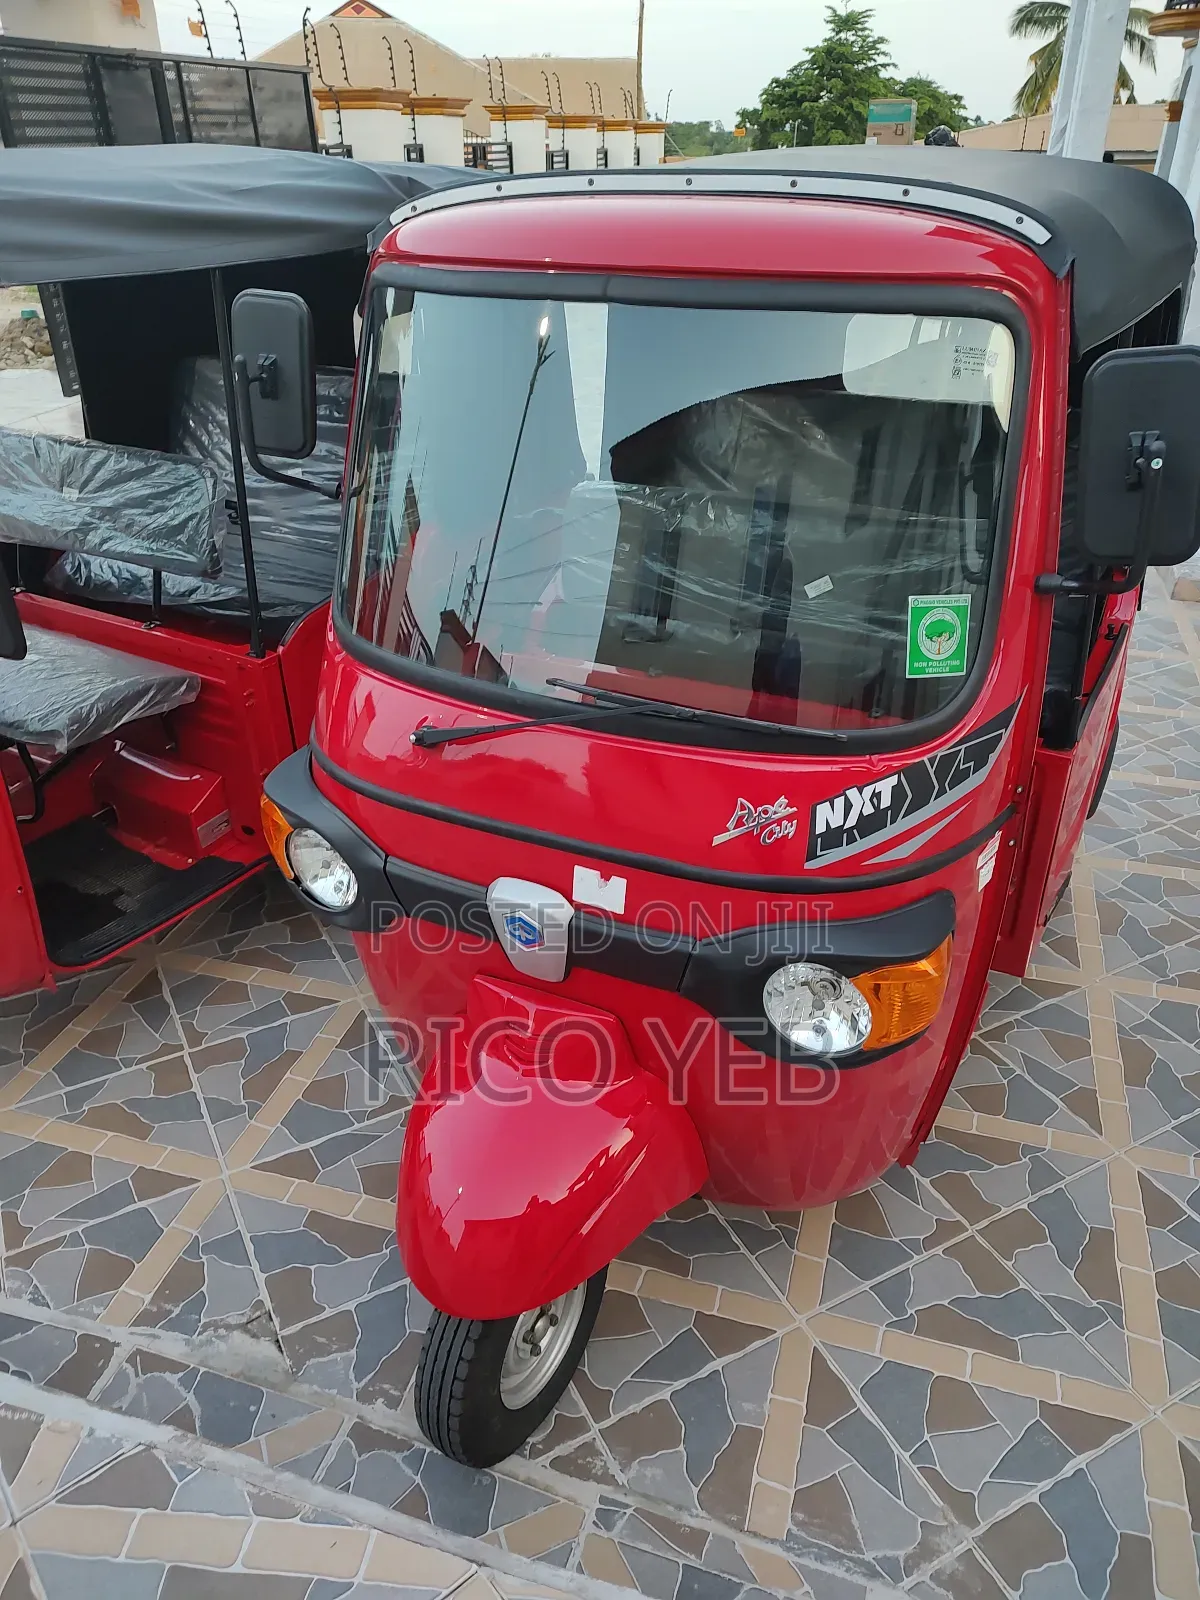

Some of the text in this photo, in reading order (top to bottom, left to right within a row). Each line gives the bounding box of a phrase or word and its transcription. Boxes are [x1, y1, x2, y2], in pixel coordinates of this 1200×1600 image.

[928, 659, 961, 667] POLLUTING
[815, 773, 899, 835] NXT
[760, 819, 798, 846] City
